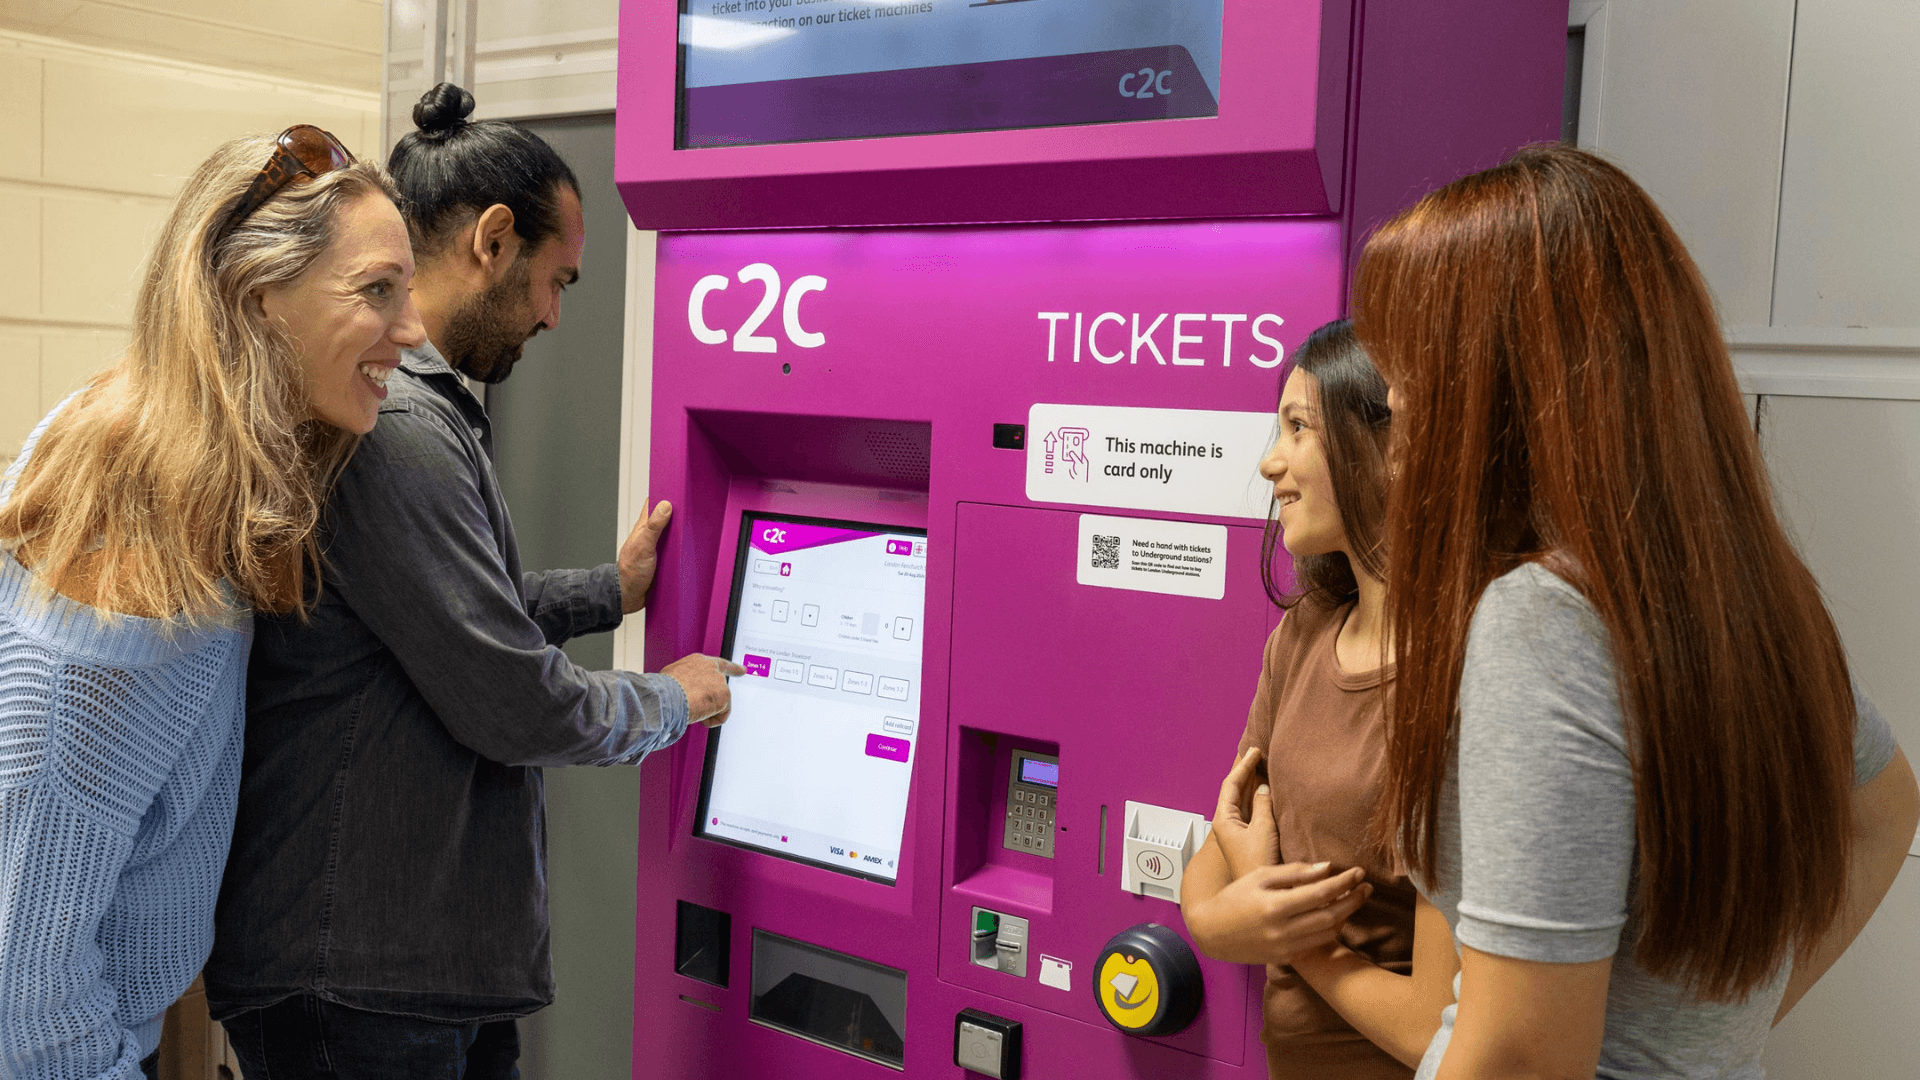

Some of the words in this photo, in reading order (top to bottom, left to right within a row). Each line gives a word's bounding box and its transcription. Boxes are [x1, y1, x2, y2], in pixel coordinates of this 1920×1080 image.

[712, 0, 741, 15] ticket
[745, 0, 766, 12] into
[768, 0, 792, 12] your
[798, 16, 813, 26] on
[816, 13, 835, 24] our
[838, 7, 871, 22] ticket
[874, 2, 933, 18] machines
[1118, 67, 1172, 99] c2c
[687, 262, 828, 354] c2c
[1038, 311, 1286, 369] TICKETS
[1105, 437, 1136, 454] This
[1140, 440, 1206, 458] machine
[1211, 443, 1223, 459] is
[1104, 462, 1136, 478] card
[1140, 464, 1173, 484] only
[763, 527, 787, 543] c2c
[1132, 539, 1149, 548] Need
[1156, 541, 1173, 550] hand
[1174, 544, 1188, 552] with
[1189, 545, 1211, 554] tickets
[1140, 550, 1182, 561] Underground
[1183, 555, 1213, 564] stations?
[830, 845, 844, 856] VISA
[863, 854, 883, 865] AMEX
